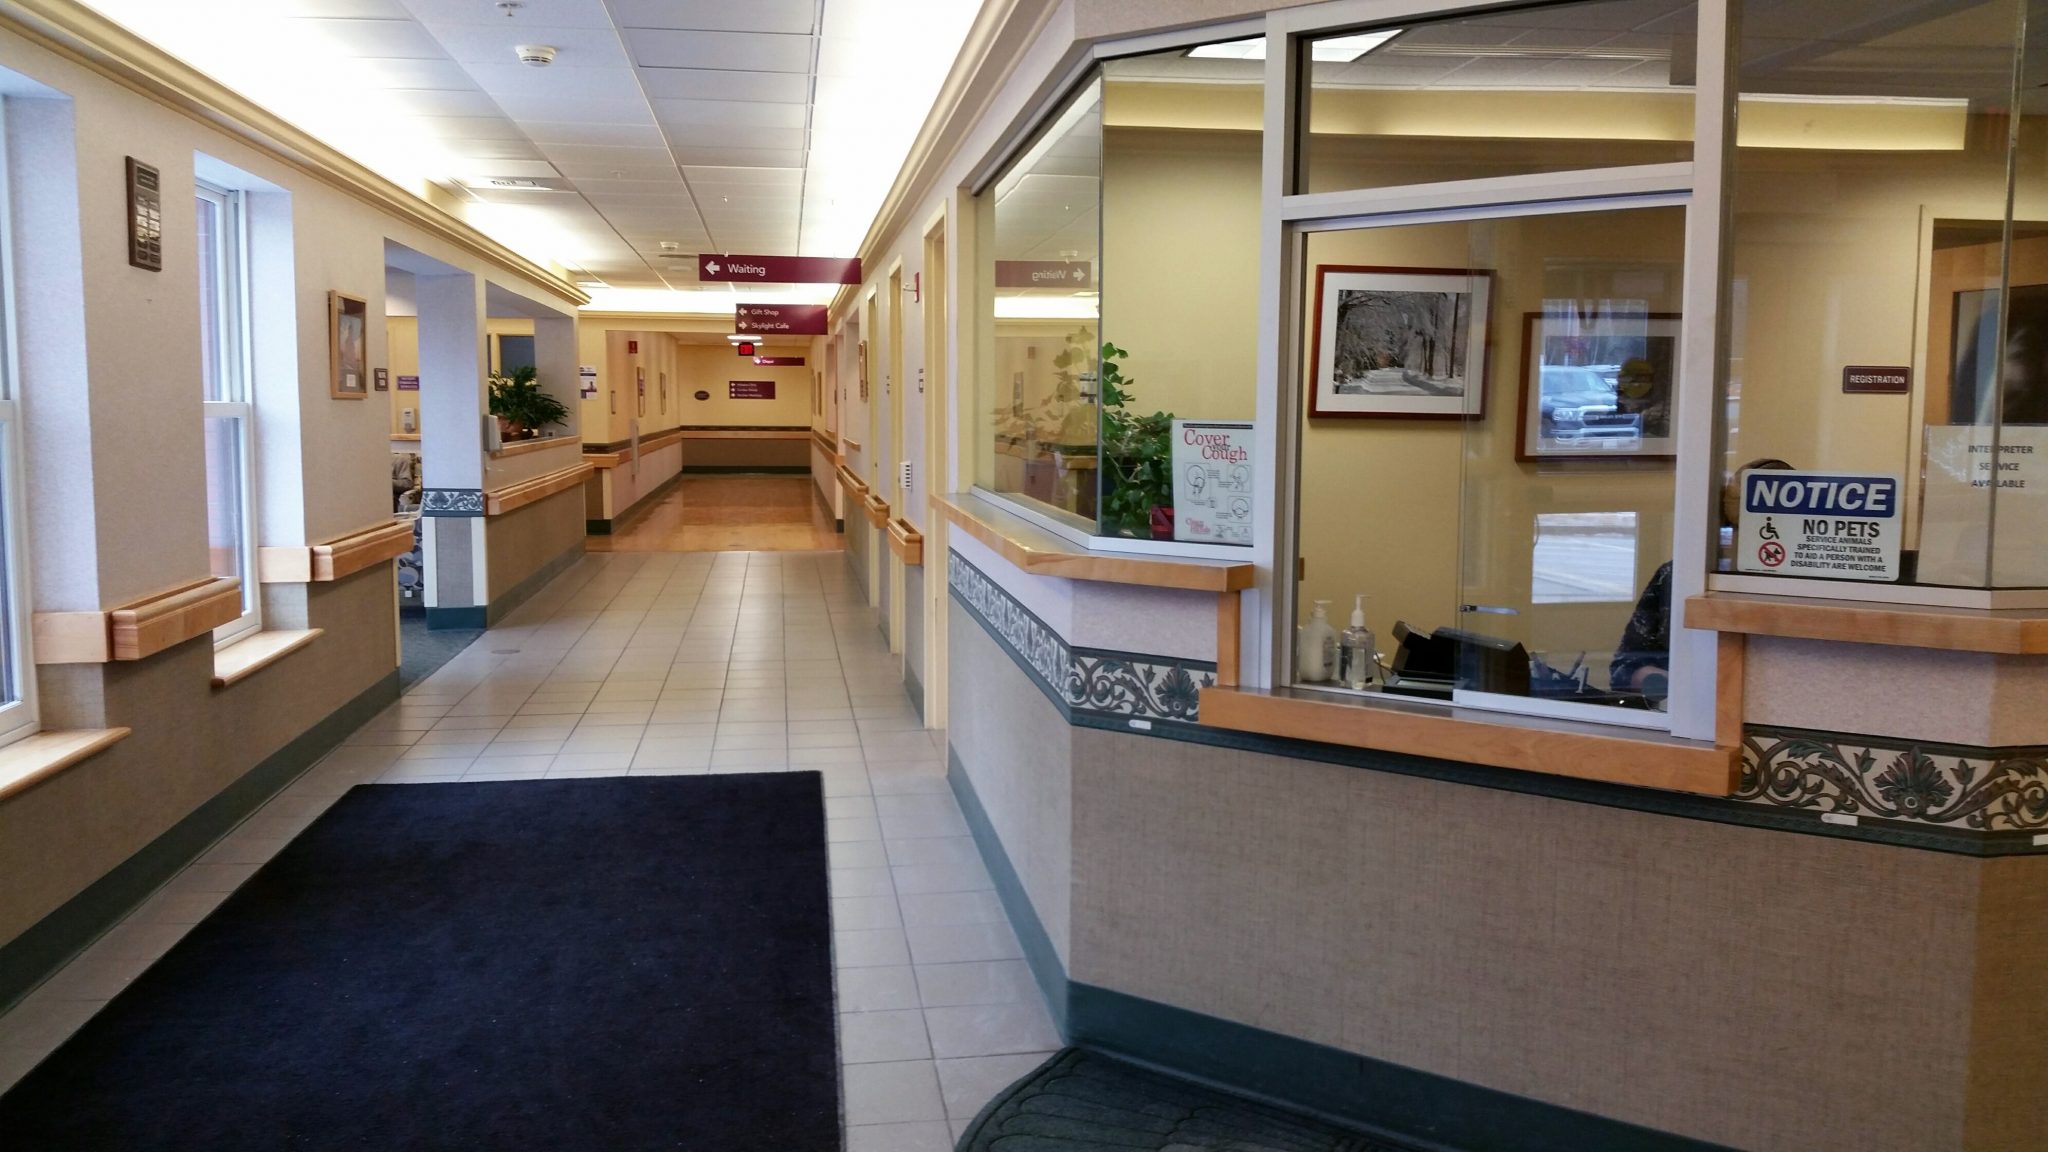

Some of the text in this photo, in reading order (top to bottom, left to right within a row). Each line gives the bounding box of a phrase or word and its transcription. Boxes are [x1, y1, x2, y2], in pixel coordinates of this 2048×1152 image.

[727, 263, 766, 277] Waiting
[763, 308, 779, 317] Shop
[1850, 374, 1905, 384] REGISTRATION
[1184, 429, 1230, 446] Cover
[1202, 445, 1248, 464] Cough
[1968, 445, 2033, 454] INTEPRETER
[1979, 463, 2020, 471] SEVICE
[1971, 480, 2025, 488] AVALABLE
[1752, 480, 1892, 512] NOTICE
[1803, 519, 1881, 538] NO PETS
[1806, 535, 1872, 546] SERVICE ANIMALS
[1797, 543, 1881, 555] SPECIFICALLY TRAINED
[1794, 551, 1804, 559] TO
[1805, 552, 1818, 560] AID
[1826, 553, 1856, 562] PERSON
[1856, 555, 1876, 563] WITH
[1790, 560, 1887, 573] DISABILITY ARE WELCOME
